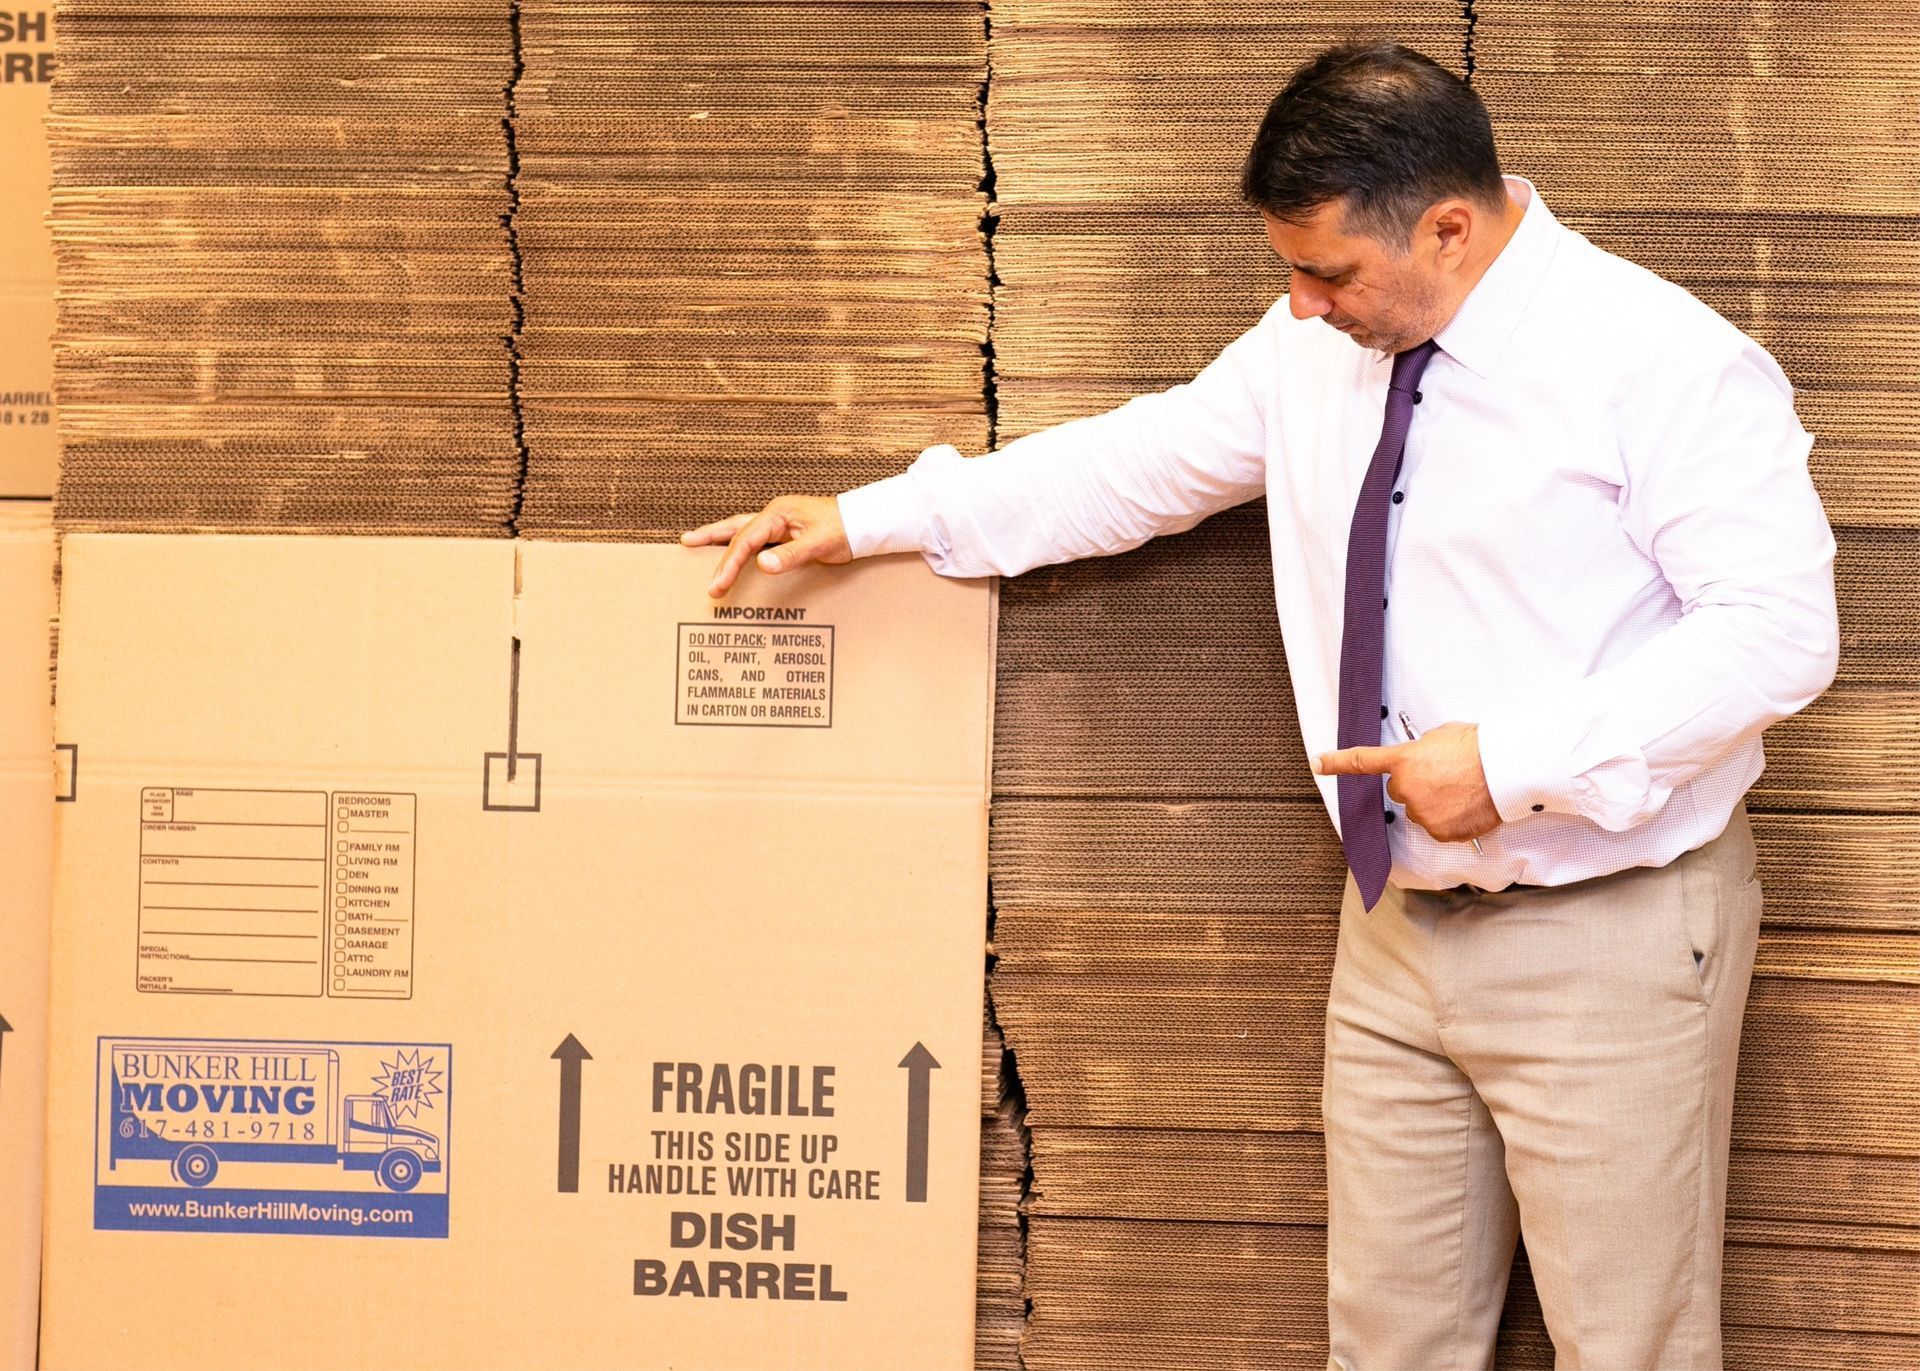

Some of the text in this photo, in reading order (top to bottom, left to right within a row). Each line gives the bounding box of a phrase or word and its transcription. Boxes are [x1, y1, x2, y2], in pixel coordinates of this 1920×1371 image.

[31, 410, 49, 424] 28
[713, 606, 807, 620] IMPORTANT
[689, 633, 825, 649] DO NOT PACK: MATCHES,
[688, 651, 826, 665] OIL, PAINT, AEROSOL
[688, 669, 825, 683] CANS, AND OTHER
[687, 686, 826, 700] FLAMMABLE MATERIALS
[687, 704, 825, 719] IN CARTON OR BARRELS.
[338, 796, 391, 806] BEDROOMS
[350, 810, 389, 818] MASTER
[350, 843, 400, 852] FAMILY RM
[349, 857, 398, 866] LIVING RM
[349, 871, 369, 879] DEN
[348, 885, 399, 894] DINING RM
[348, 899, 390, 908] KITCHEN
[348, 913, 373, 921] BATH
[347, 927, 400, 935] BASEMENT
[347, 940, 388, 949] GARAGE
[347, 954, 374, 962] ATTIC
[346, 968, 409, 978] LAUNDRY RM
[122, 1054, 316, 1081] BUNKER HILL
[391, 1068, 424, 1087] BEST
[391, 1084, 424, 1102] RATE
[651, 1061, 836, 1117] FRAGILE
[120, 1083, 315, 1115] MOVING
[119, 1117, 315, 1140] 617-481-9718
[651, 1130, 838, 1164] THIS SIDE UP
[608, 1163, 880, 1200] HANDLE WITH CARE
[128, 1199, 413, 1225] www.BunkerHillMoving.com
[670, 1211, 796, 1251] DISH
[633, 1259, 848, 1302] BARREL
